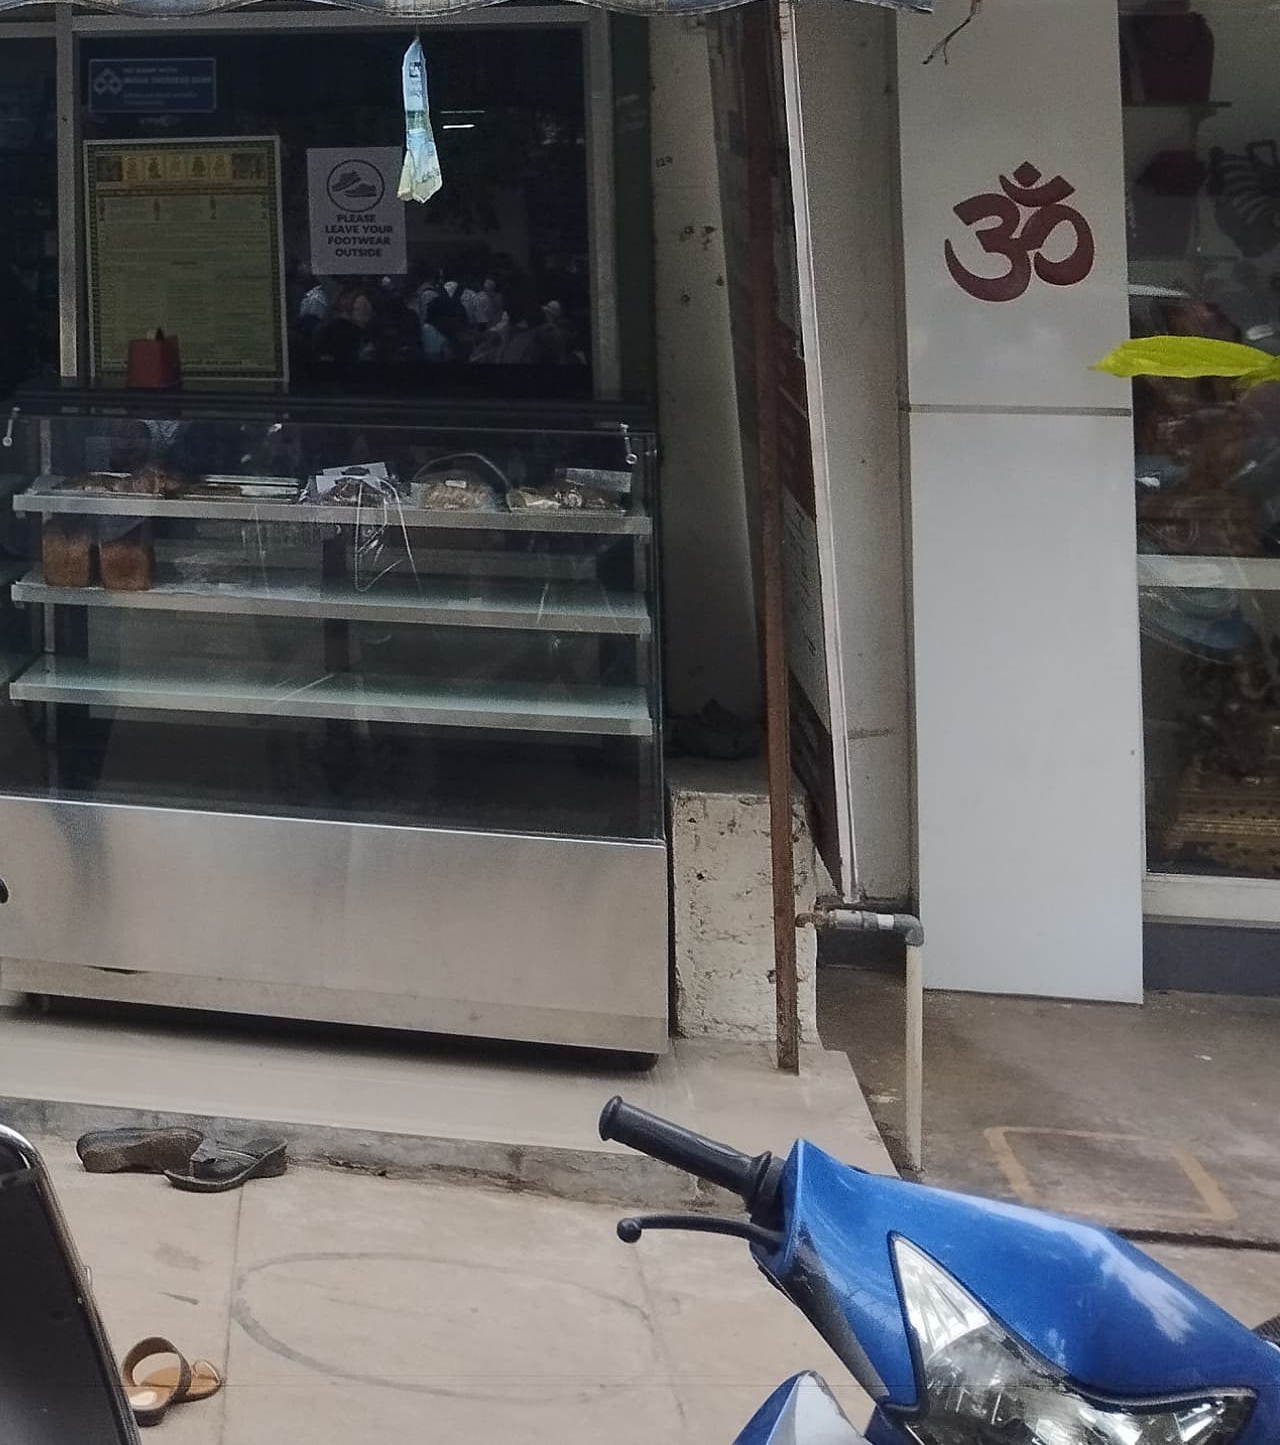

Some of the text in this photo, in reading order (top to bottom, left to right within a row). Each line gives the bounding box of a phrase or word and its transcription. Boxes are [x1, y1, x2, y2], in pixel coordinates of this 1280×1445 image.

[335, 214, 377, 224] PLEASE
[325, 225, 394, 235] LEAVE YOUR
[327, 236, 391, 246] FOOTWEAR
